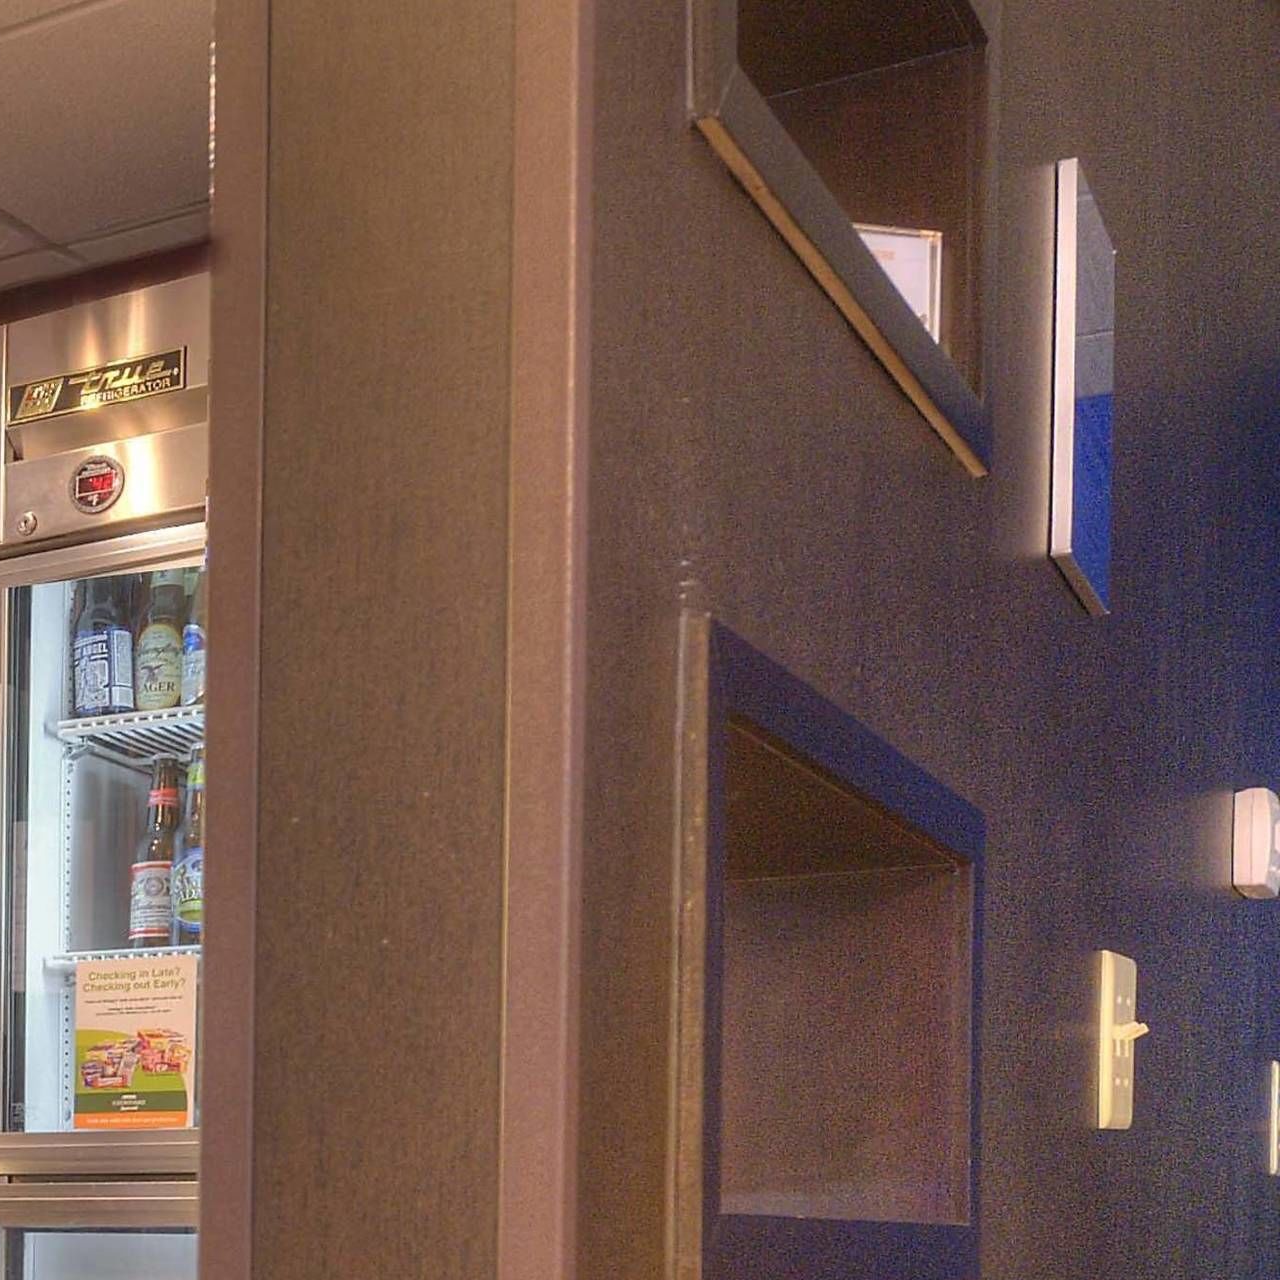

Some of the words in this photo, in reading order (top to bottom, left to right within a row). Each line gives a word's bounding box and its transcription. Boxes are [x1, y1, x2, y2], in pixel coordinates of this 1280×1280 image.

[81, 377, 171, 407] REFRIGERATOR
[88, 971, 137, 981] Checking
[139, 970, 149, 978] in
[151, 967, 181, 978] Late?
[83, 982, 132, 993] Checking
[132, 980, 150, 990] out
[153, 978, 186, 989] Early?
